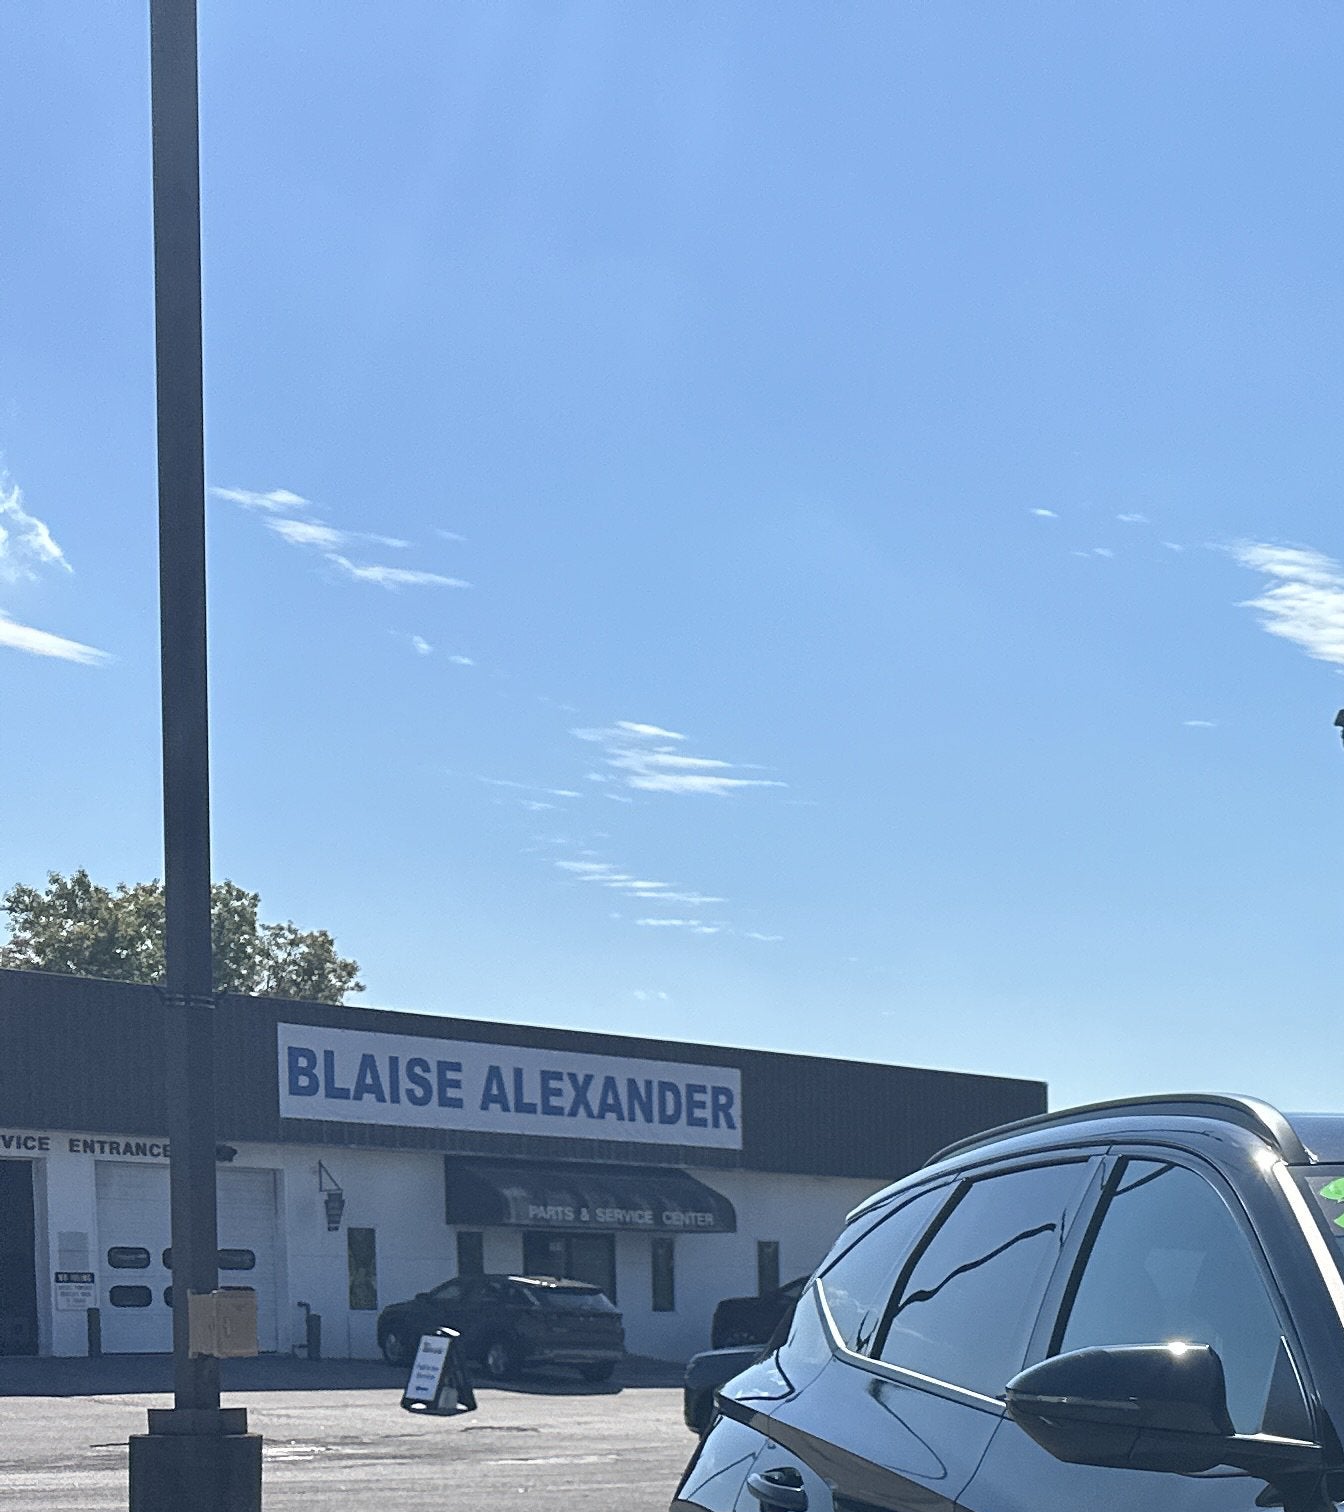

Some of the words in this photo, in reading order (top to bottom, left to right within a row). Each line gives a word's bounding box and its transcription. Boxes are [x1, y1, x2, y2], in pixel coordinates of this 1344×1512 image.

[287, 1046, 464, 1109] BLAISE
[479, 1064, 738, 1130] ALEXANDER
[0, 1134, 51, 1151] VICE
[528, 1205, 575, 1221] PARTS
[580, 1207, 590, 1221] &
[595, 1208, 654, 1225] SERVICE
[662, 1211, 714, 1226] CENTER
